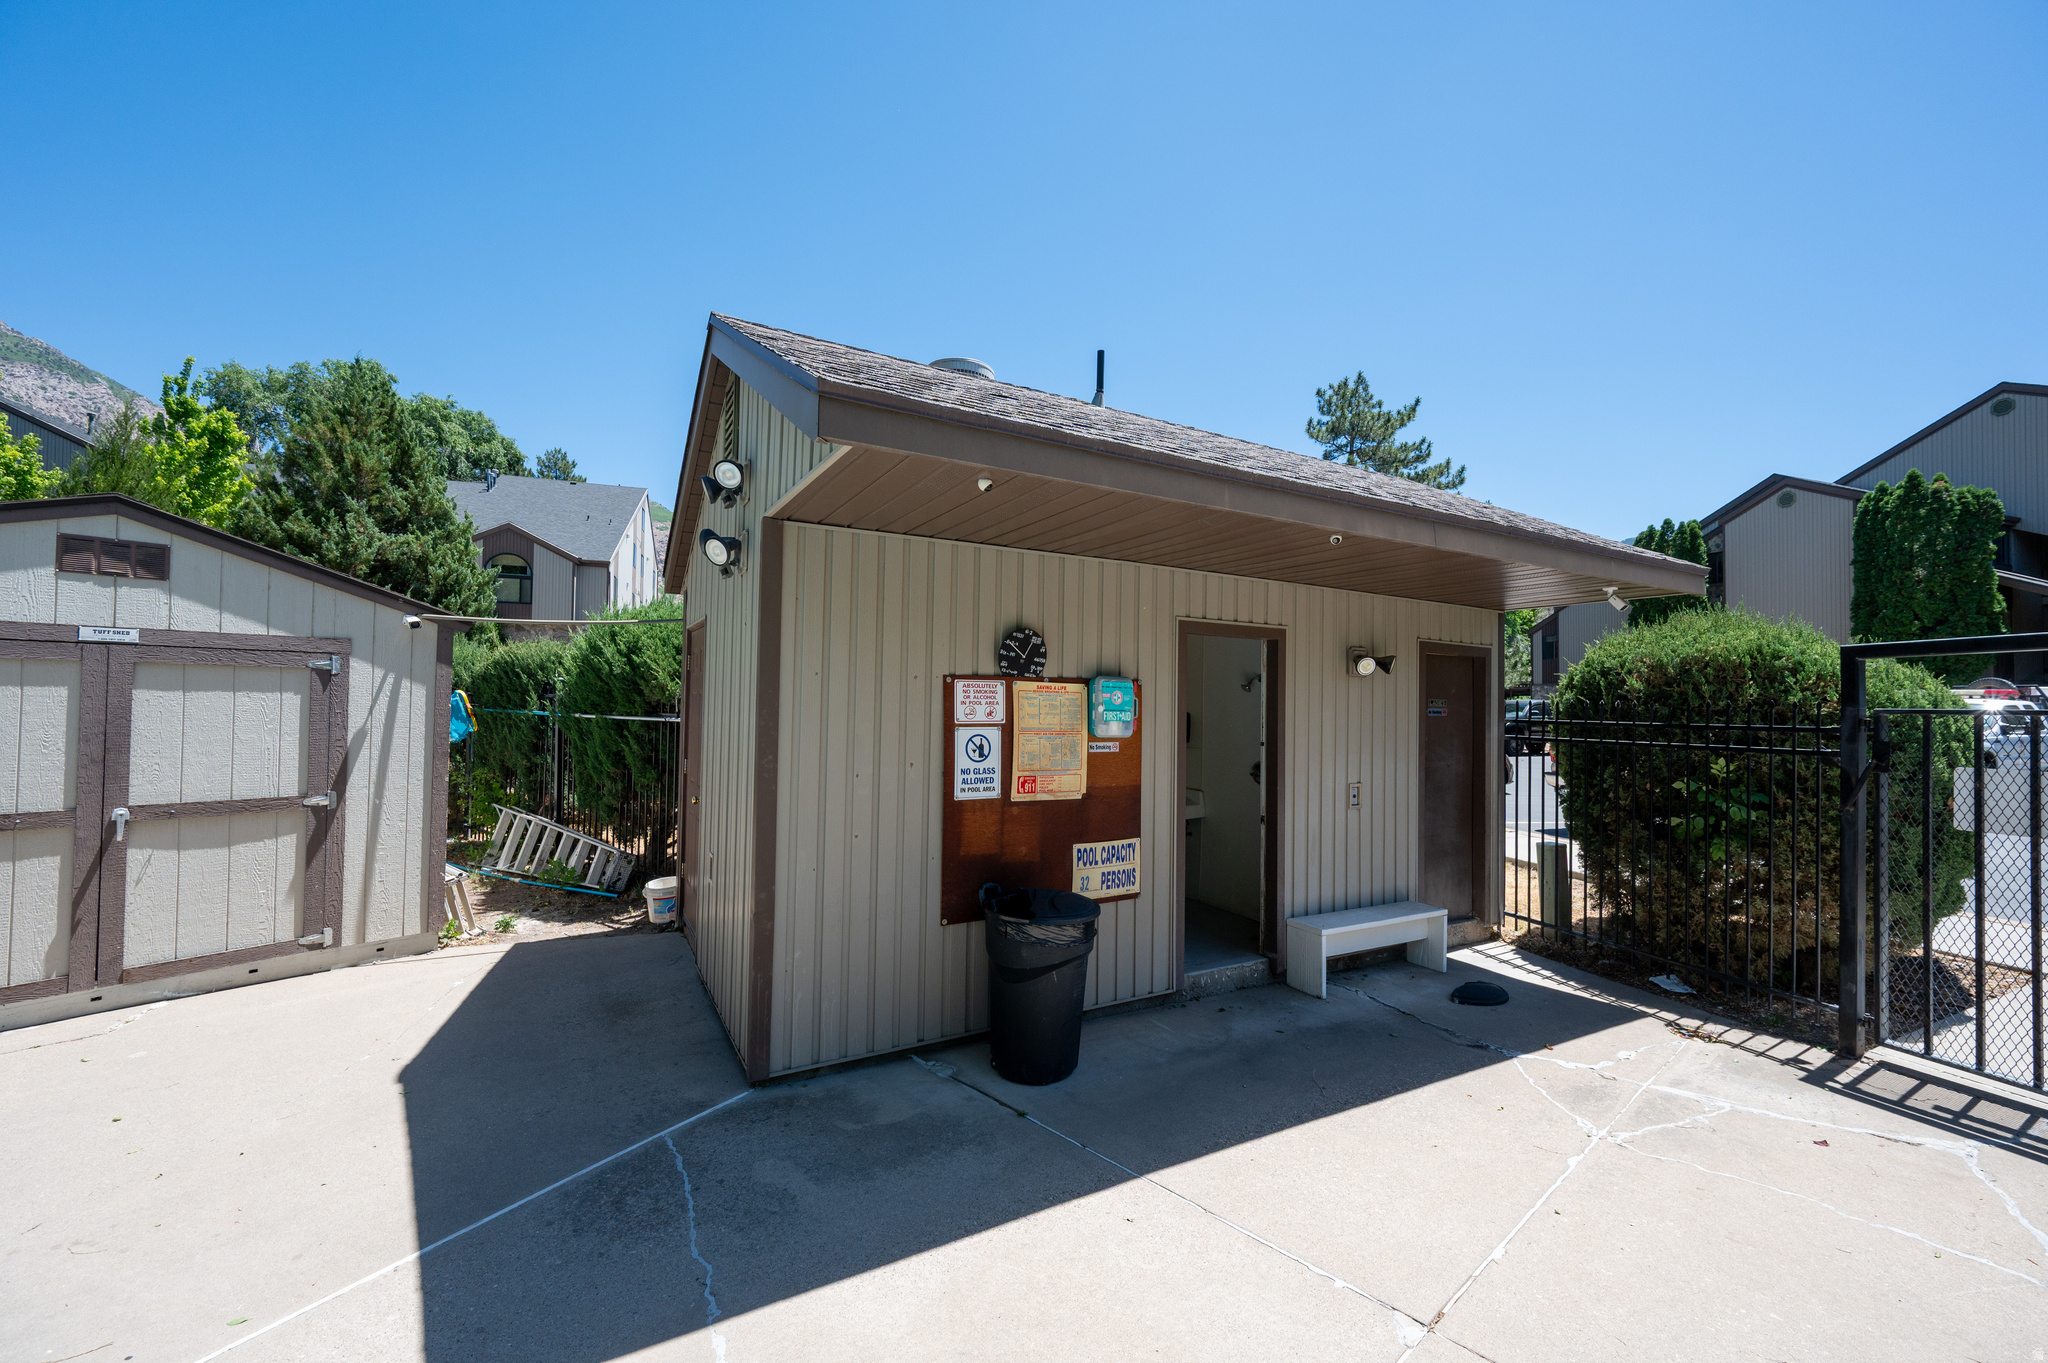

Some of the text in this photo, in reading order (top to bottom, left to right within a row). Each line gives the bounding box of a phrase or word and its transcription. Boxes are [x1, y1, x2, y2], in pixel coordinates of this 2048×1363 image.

[960, 767, 996, 776] NO GLASS
[961, 777, 995, 785] ALLOWED
[1025, 783, 1036, 792] 911
[1076, 842, 1136, 868] POOL CAPACITY
[1080, 868, 1136, 891] 32 PERSONS
